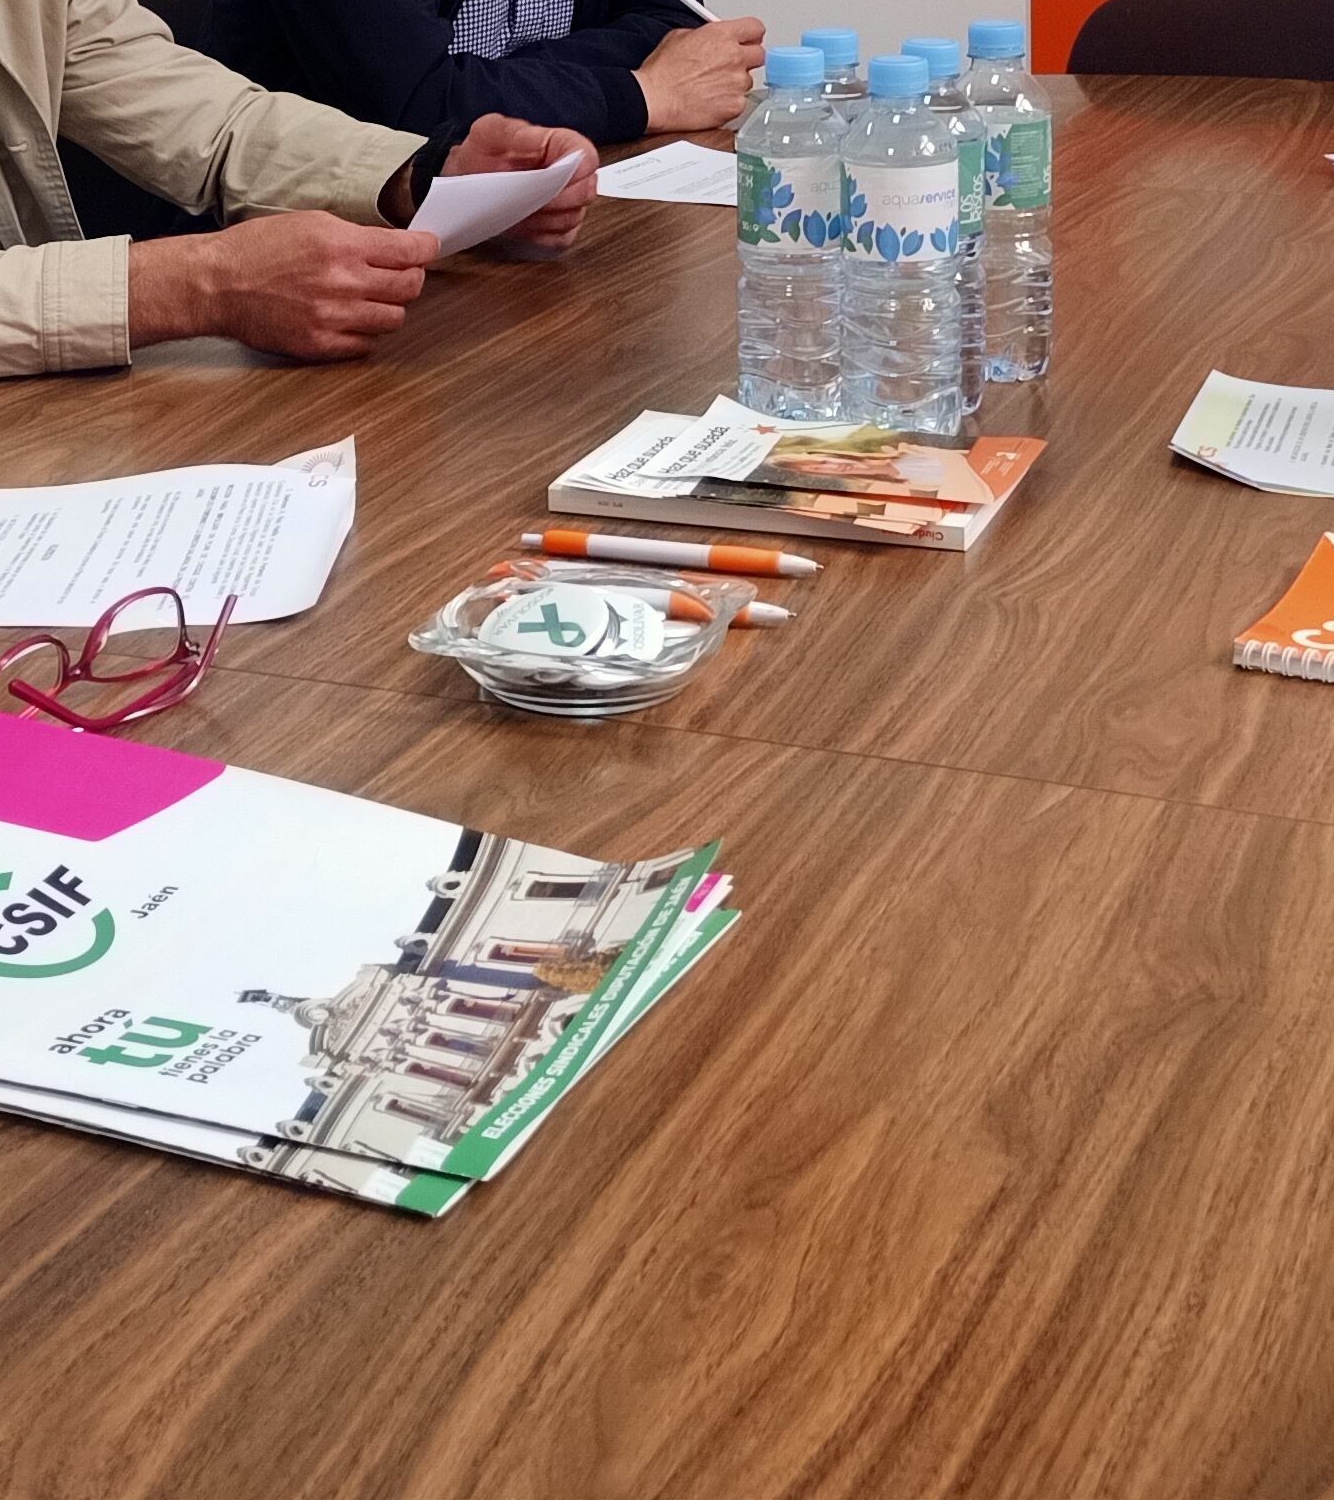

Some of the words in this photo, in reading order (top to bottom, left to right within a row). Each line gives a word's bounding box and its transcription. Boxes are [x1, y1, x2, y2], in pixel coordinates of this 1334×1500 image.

[129, 884, 179, 920] Jaén
[48, 1008, 131, 1054] ahora
[76, 1015, 214, 1068] tú
[481, 1076, 557, 1140] ELECCIONES
[545, 1002, 611, 1077] SINDICALES
[601, 927, 663, 1004] DIPUTACIÓN
[651, 906, 675, 927] DE
[158, 1041, 220, 1078] tienes
[208, 1028, 238, 1042] la
[186, 1032, 263, 1084] palabra
